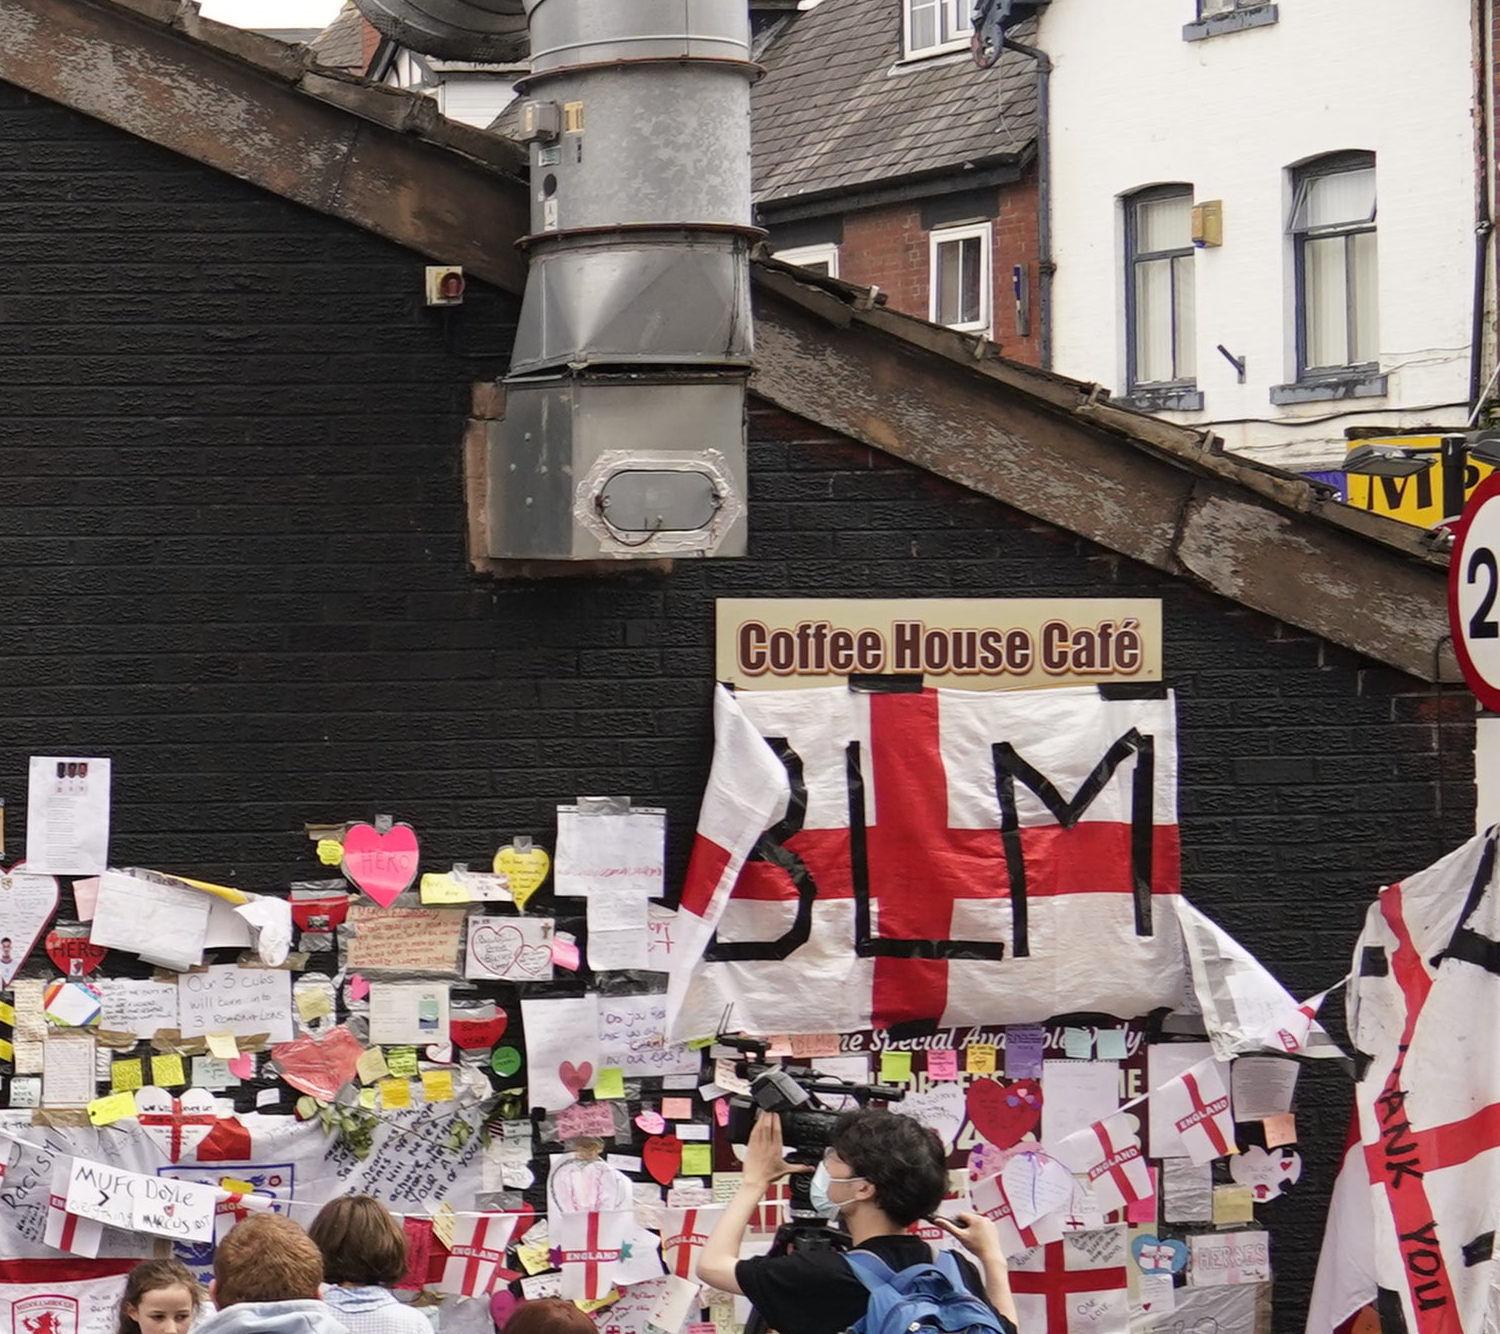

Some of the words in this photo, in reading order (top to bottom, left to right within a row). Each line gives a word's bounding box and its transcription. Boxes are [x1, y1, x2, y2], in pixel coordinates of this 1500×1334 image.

[739, 620, 884, 676] Coffee
[894, 620, 1031, 676] House
[1041, 617, 1142, 675] Café
[360, 852, 409, 873] HERO
[224, 973, 235, 989] 3
[194, 1014, 205, 1028] 3
[1180, 1098, 1229, 1132] ENGLAND
[1088, 1147, 1138, 1181] ENGLAND
[75, 1166, 136, 1197] MUFC
[452, 1244, 499, 1263] ENGLAND
[565, 1248, 621, 1262] ENGLAND
[1199, 1244, 1267, 1268] HEROES
[1400, 1222, 1447, 1312] YOU
